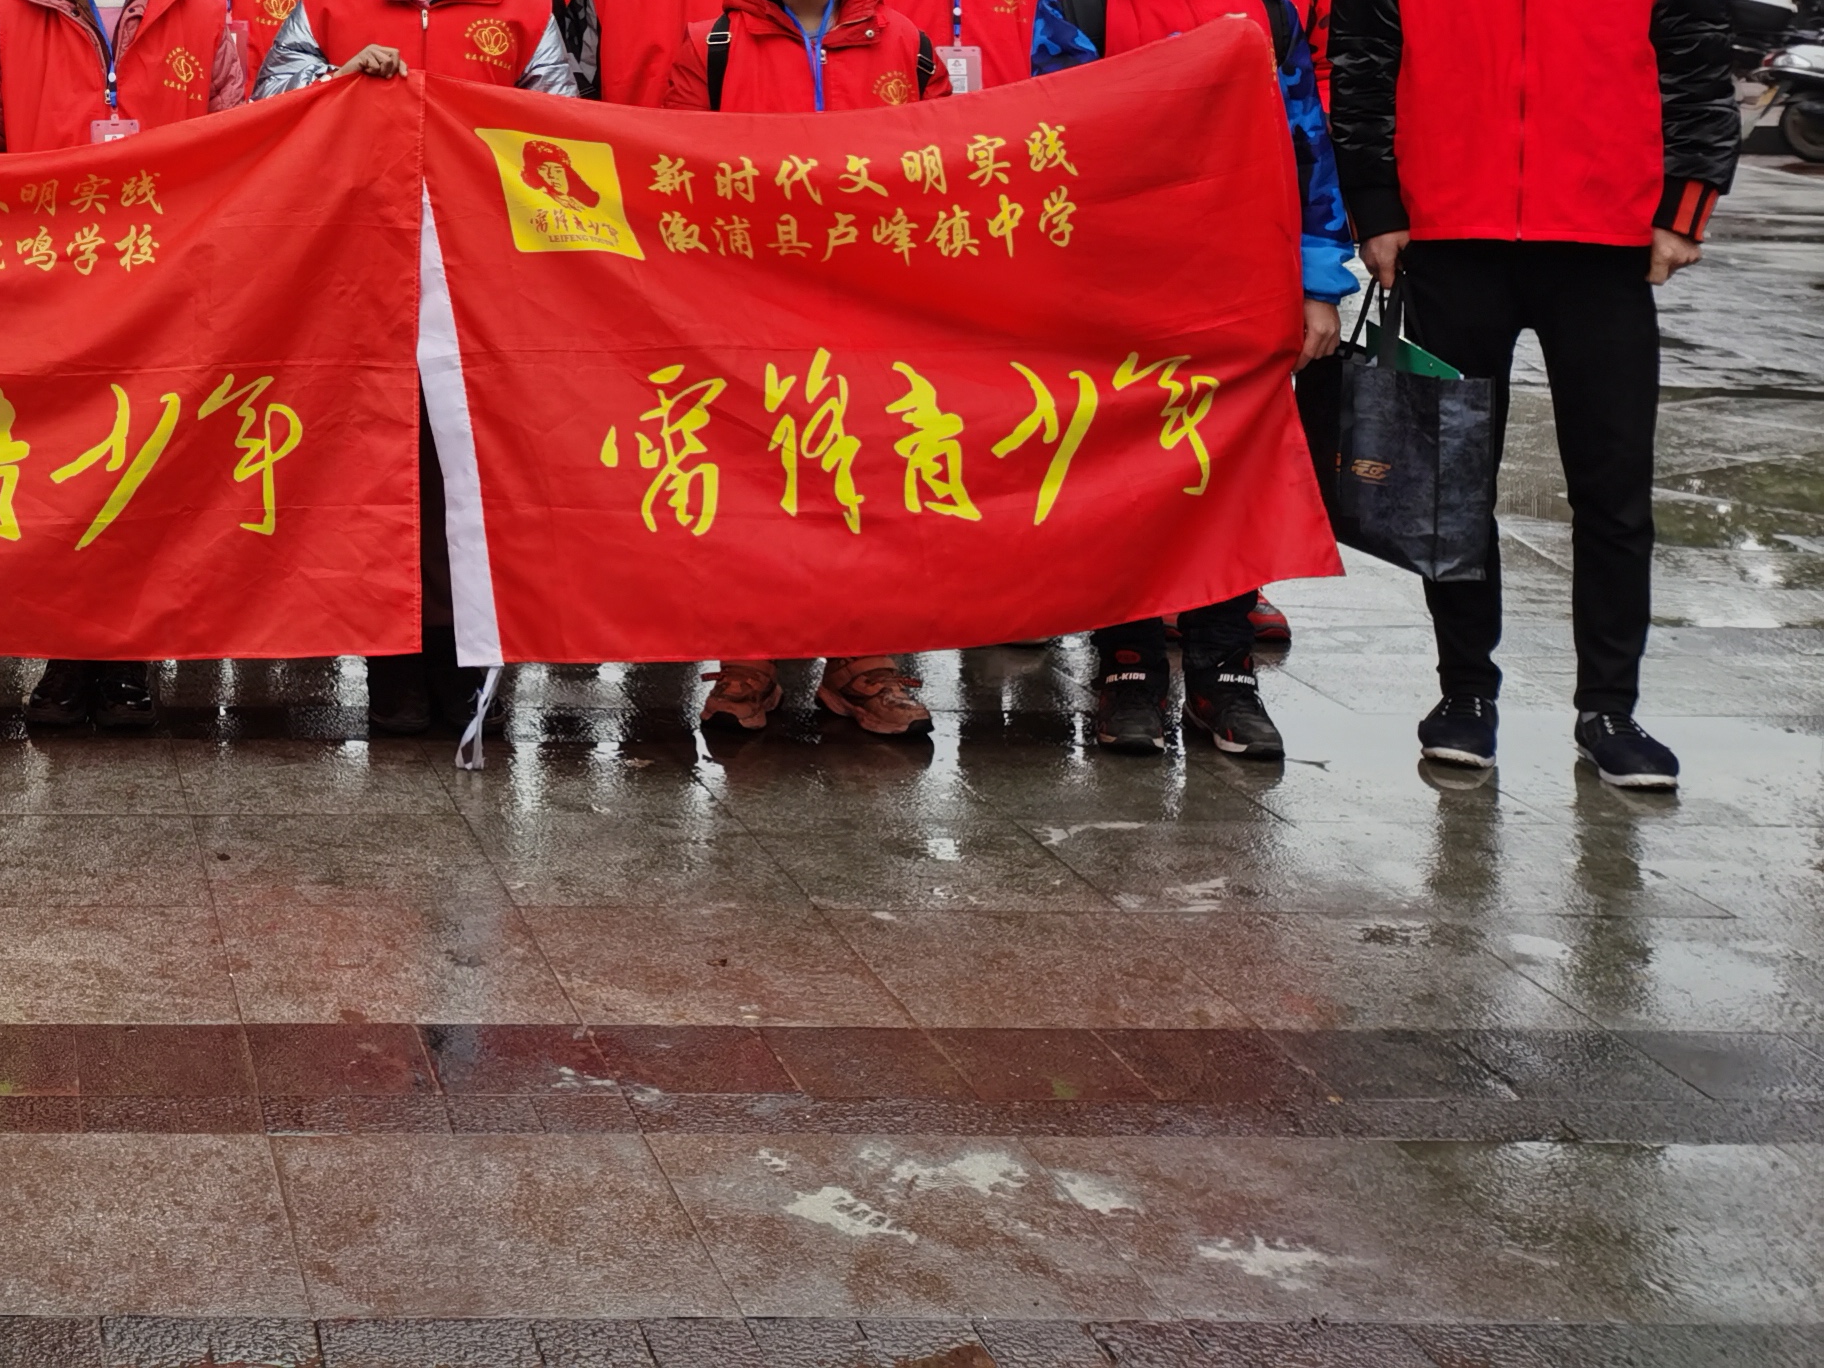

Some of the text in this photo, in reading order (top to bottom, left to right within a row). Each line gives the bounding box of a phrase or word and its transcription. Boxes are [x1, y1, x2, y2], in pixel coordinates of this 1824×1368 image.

[648, 122, 1079, 206] 新时代文明实践
[548, 234, 589, 243] LEIFENG
[658, 185, 1078, 267] 溆浦县卢峰镇中学
[600, 346, 1221, 537] 雷锋青少年
